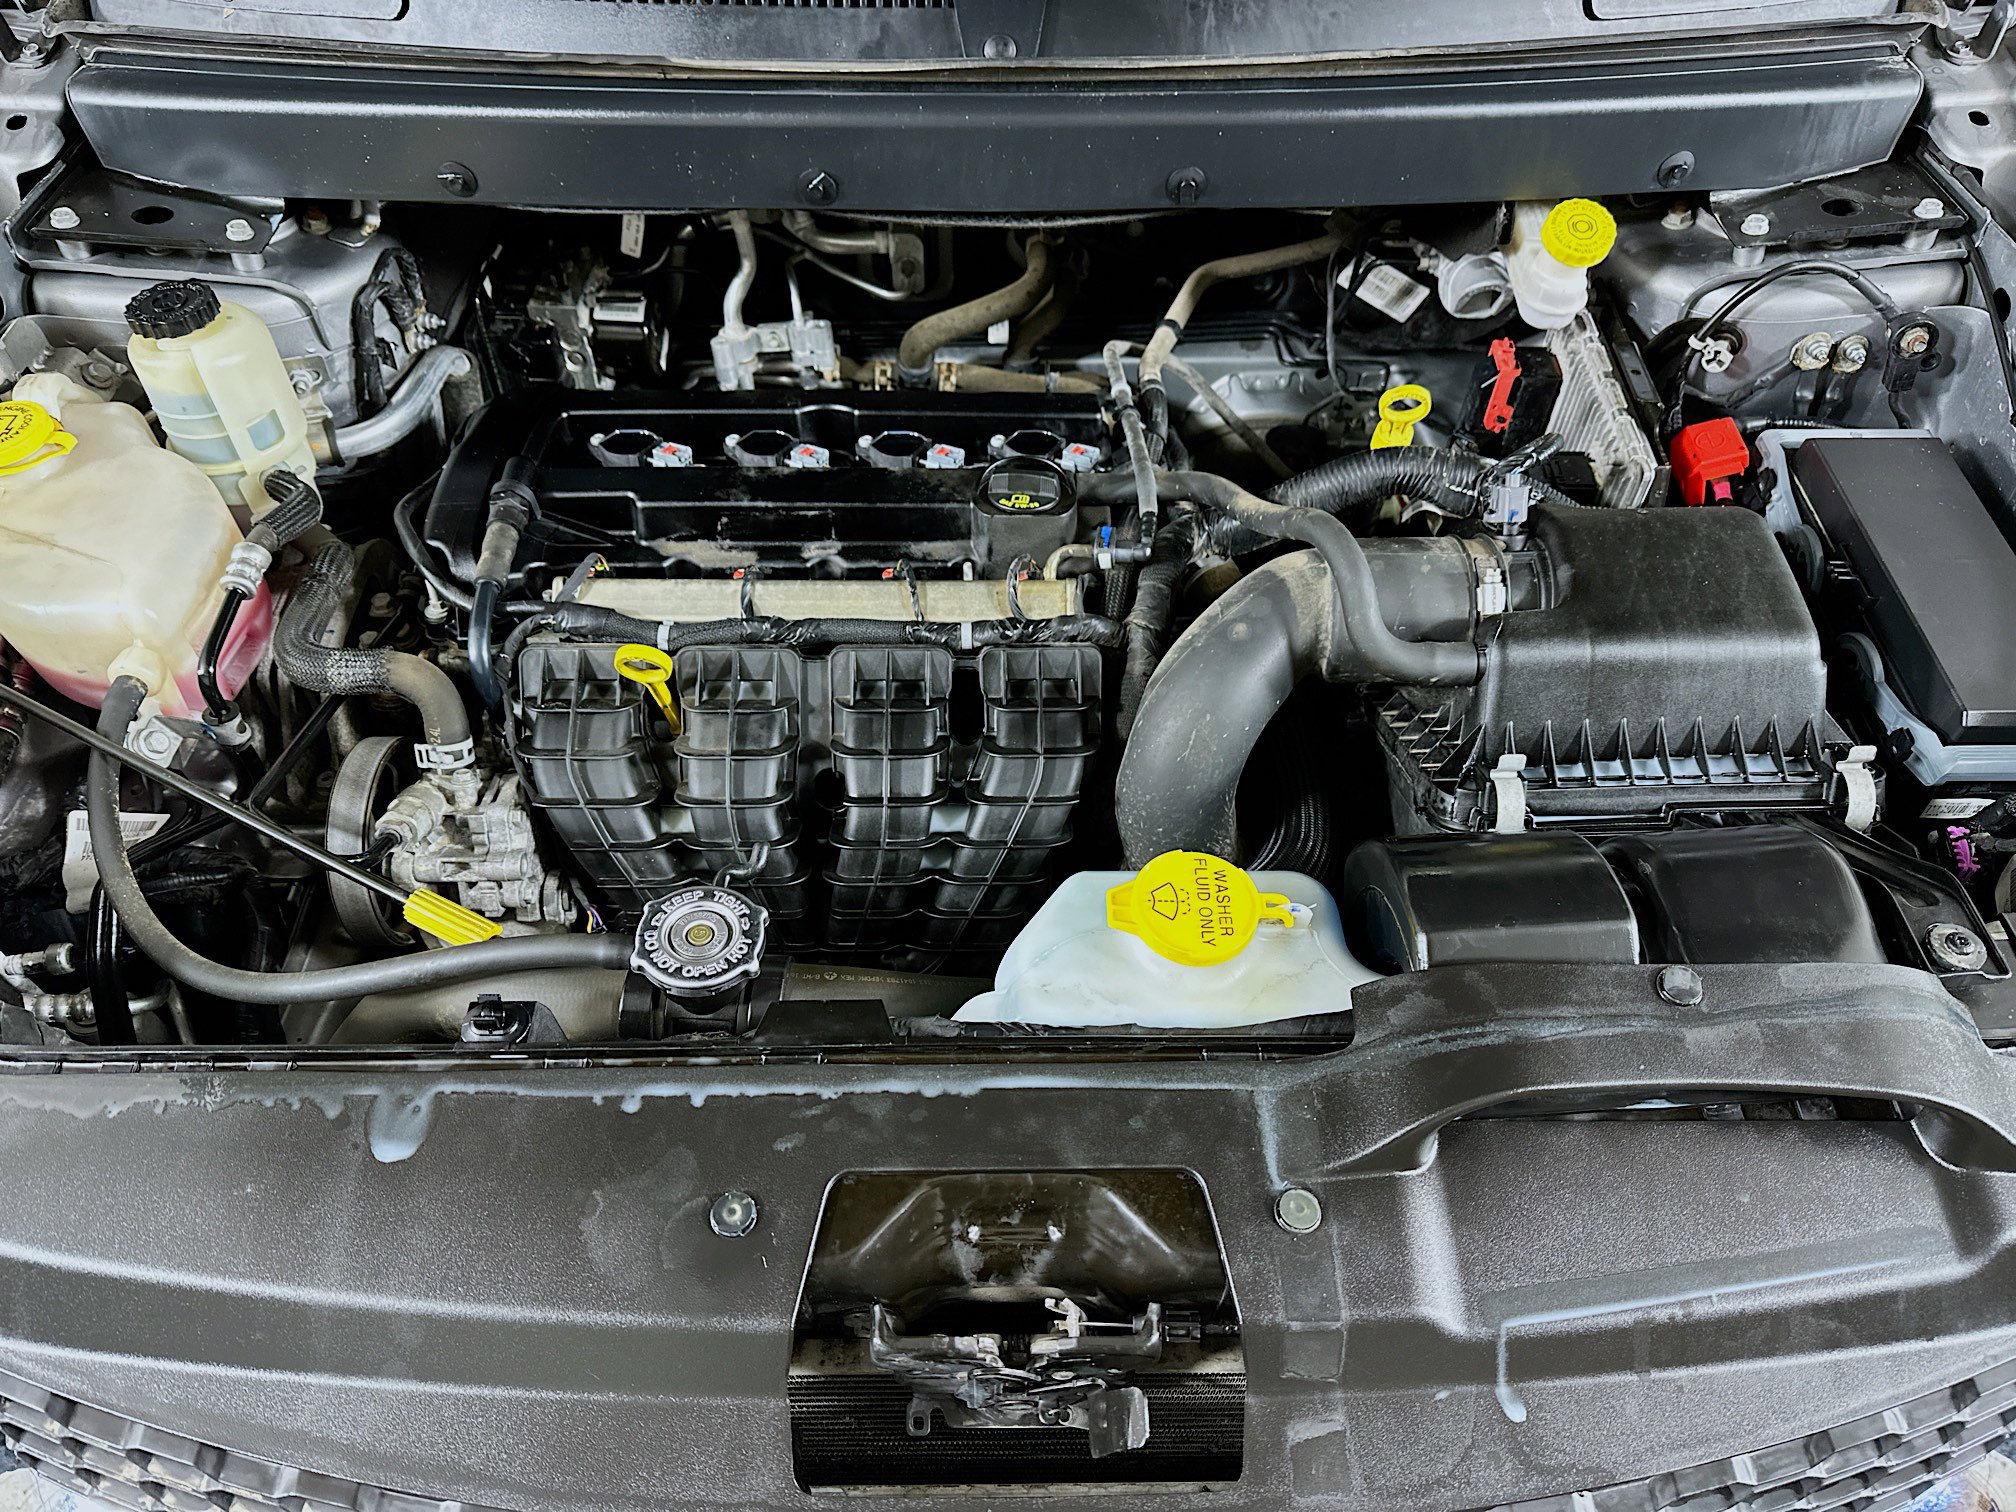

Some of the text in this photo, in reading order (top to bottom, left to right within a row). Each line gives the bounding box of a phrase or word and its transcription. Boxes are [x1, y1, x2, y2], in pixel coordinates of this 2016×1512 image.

[661, 890, 750, 915] KEEP TIGHT
[1193, 858, 1217, 947] FLUID ONLY
[1213, 869, 1234, 936] WASHER
[643, 929, 659, 951] DO
[727, 937, 752, 963] HOT
[650, 950, 681, 973] NOT
[682, 959, 729, 977] OPEN
